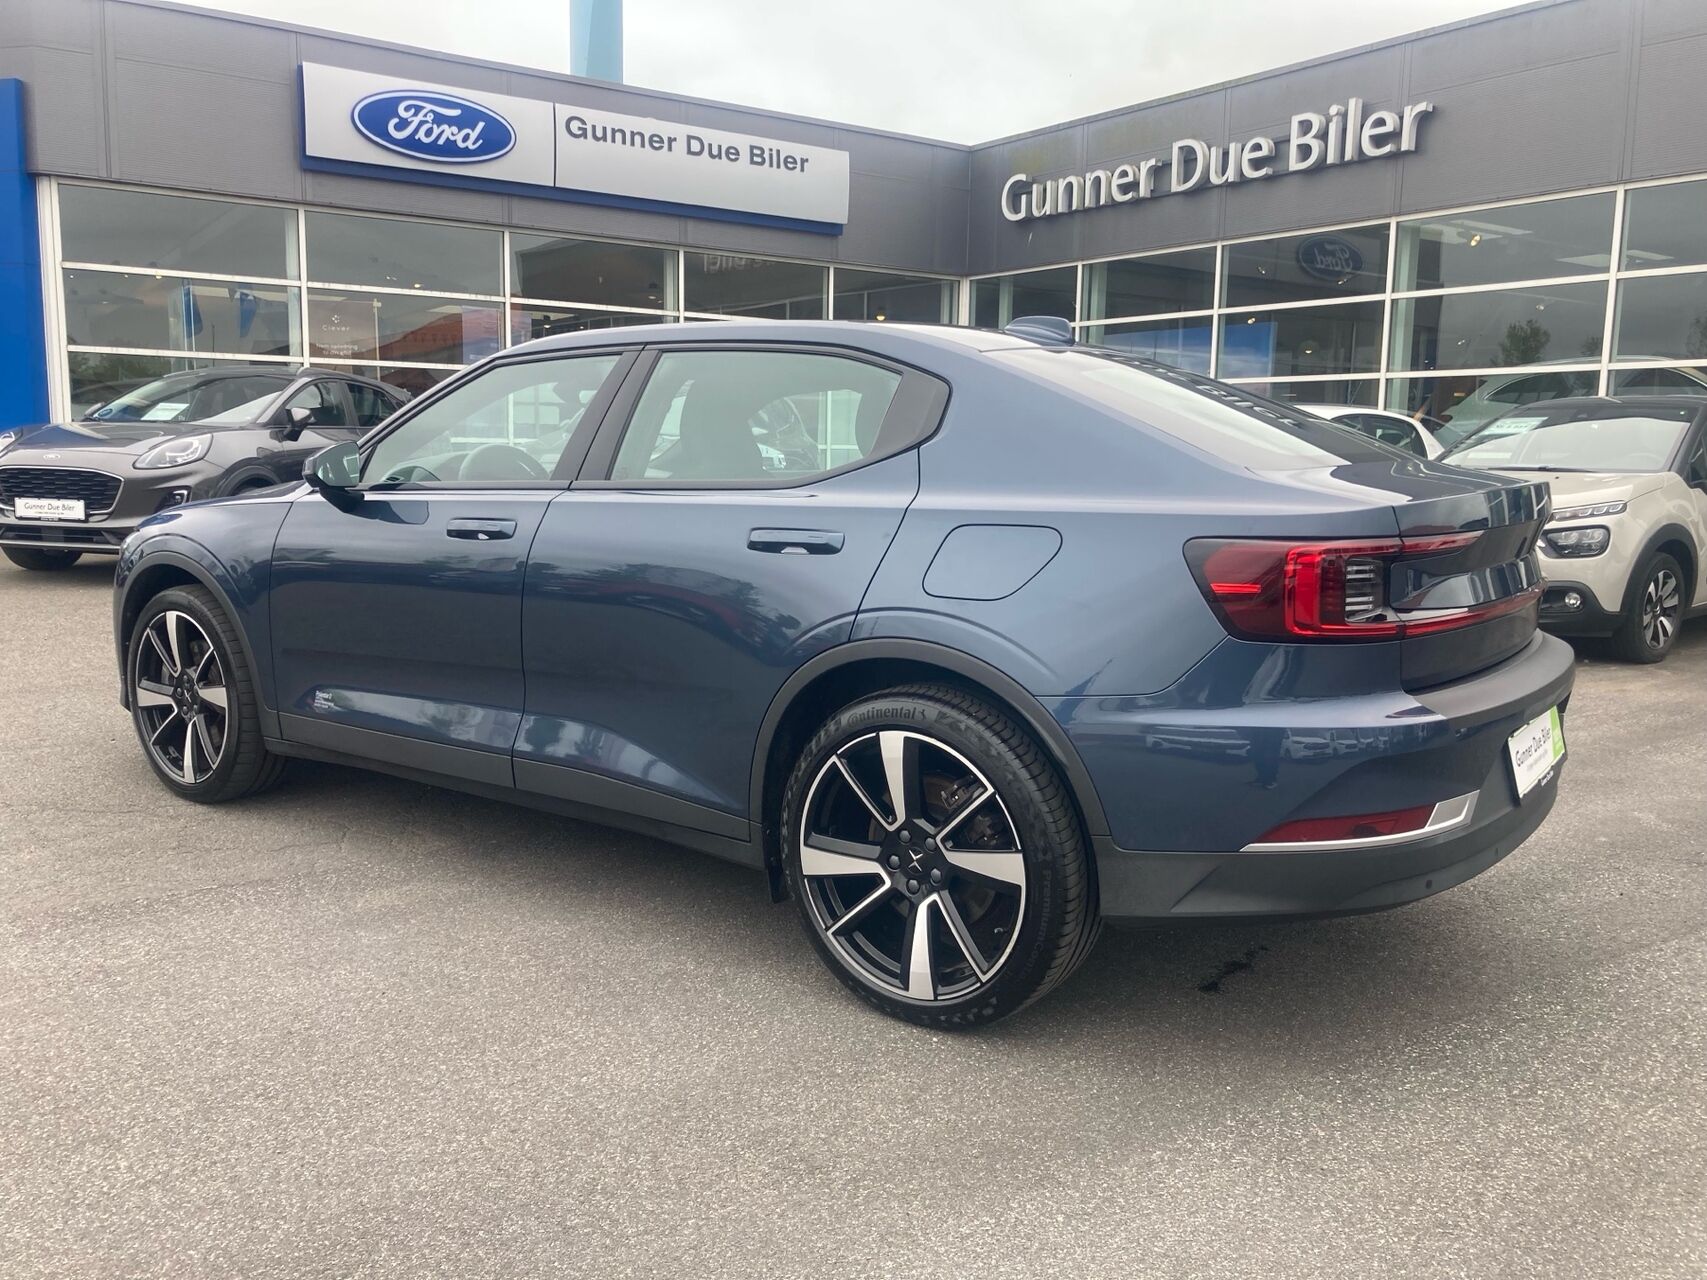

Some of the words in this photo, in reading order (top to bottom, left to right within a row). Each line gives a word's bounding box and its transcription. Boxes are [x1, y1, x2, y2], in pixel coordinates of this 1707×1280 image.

[387, 100, 486, 150] Ford
[565, 115, 677, 153] Gunner
[686, 134, 740, 163] Due
[749, 144, 809, 173] Biler
[1001, 157, 1163, 222] Gunner
[1171, 136, 1276, 194] Due
[1289, 97, 1433, 173] Biler
[24, 502, 46, 510] Gunner
[47, 503, 60, 511] Due
[61, 504, 75, 512] Biler
[847, 706, 917, 728] Continental
